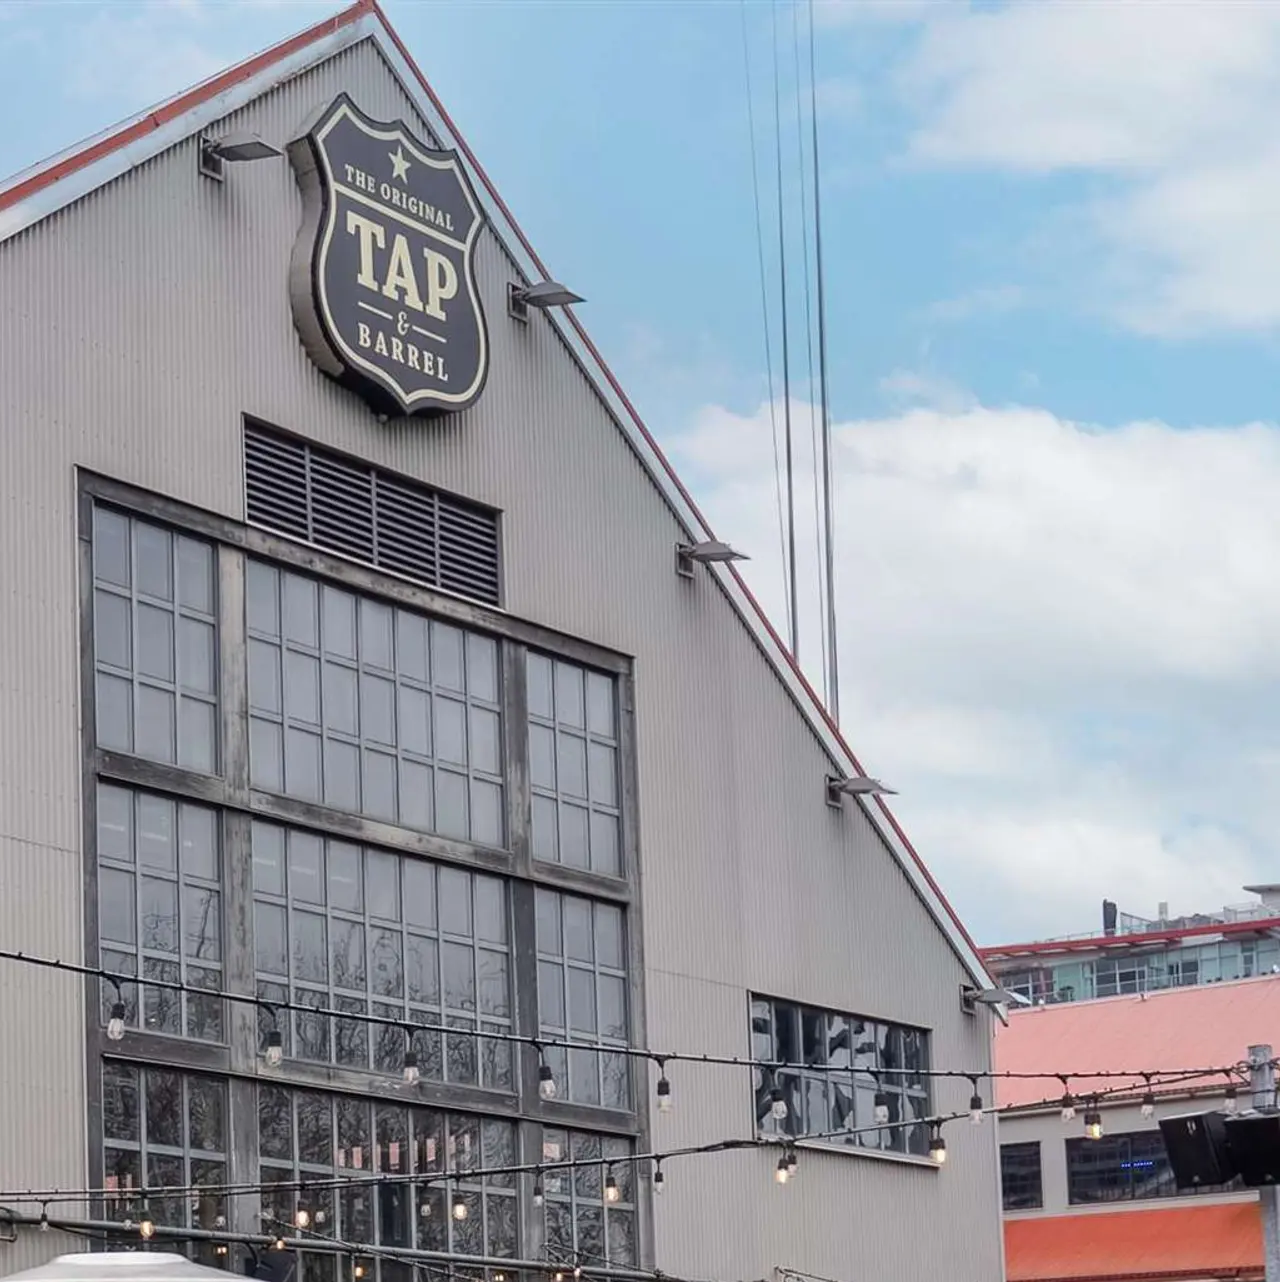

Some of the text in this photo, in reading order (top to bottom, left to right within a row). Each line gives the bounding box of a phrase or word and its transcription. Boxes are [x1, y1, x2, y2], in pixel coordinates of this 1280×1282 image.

[344, 163, 454, 232] THE ORIGINAL
[346, 210, 458, 322] TAP
[358, 322, 448, 382] BARREL
[397, 311, 410, 336] &
